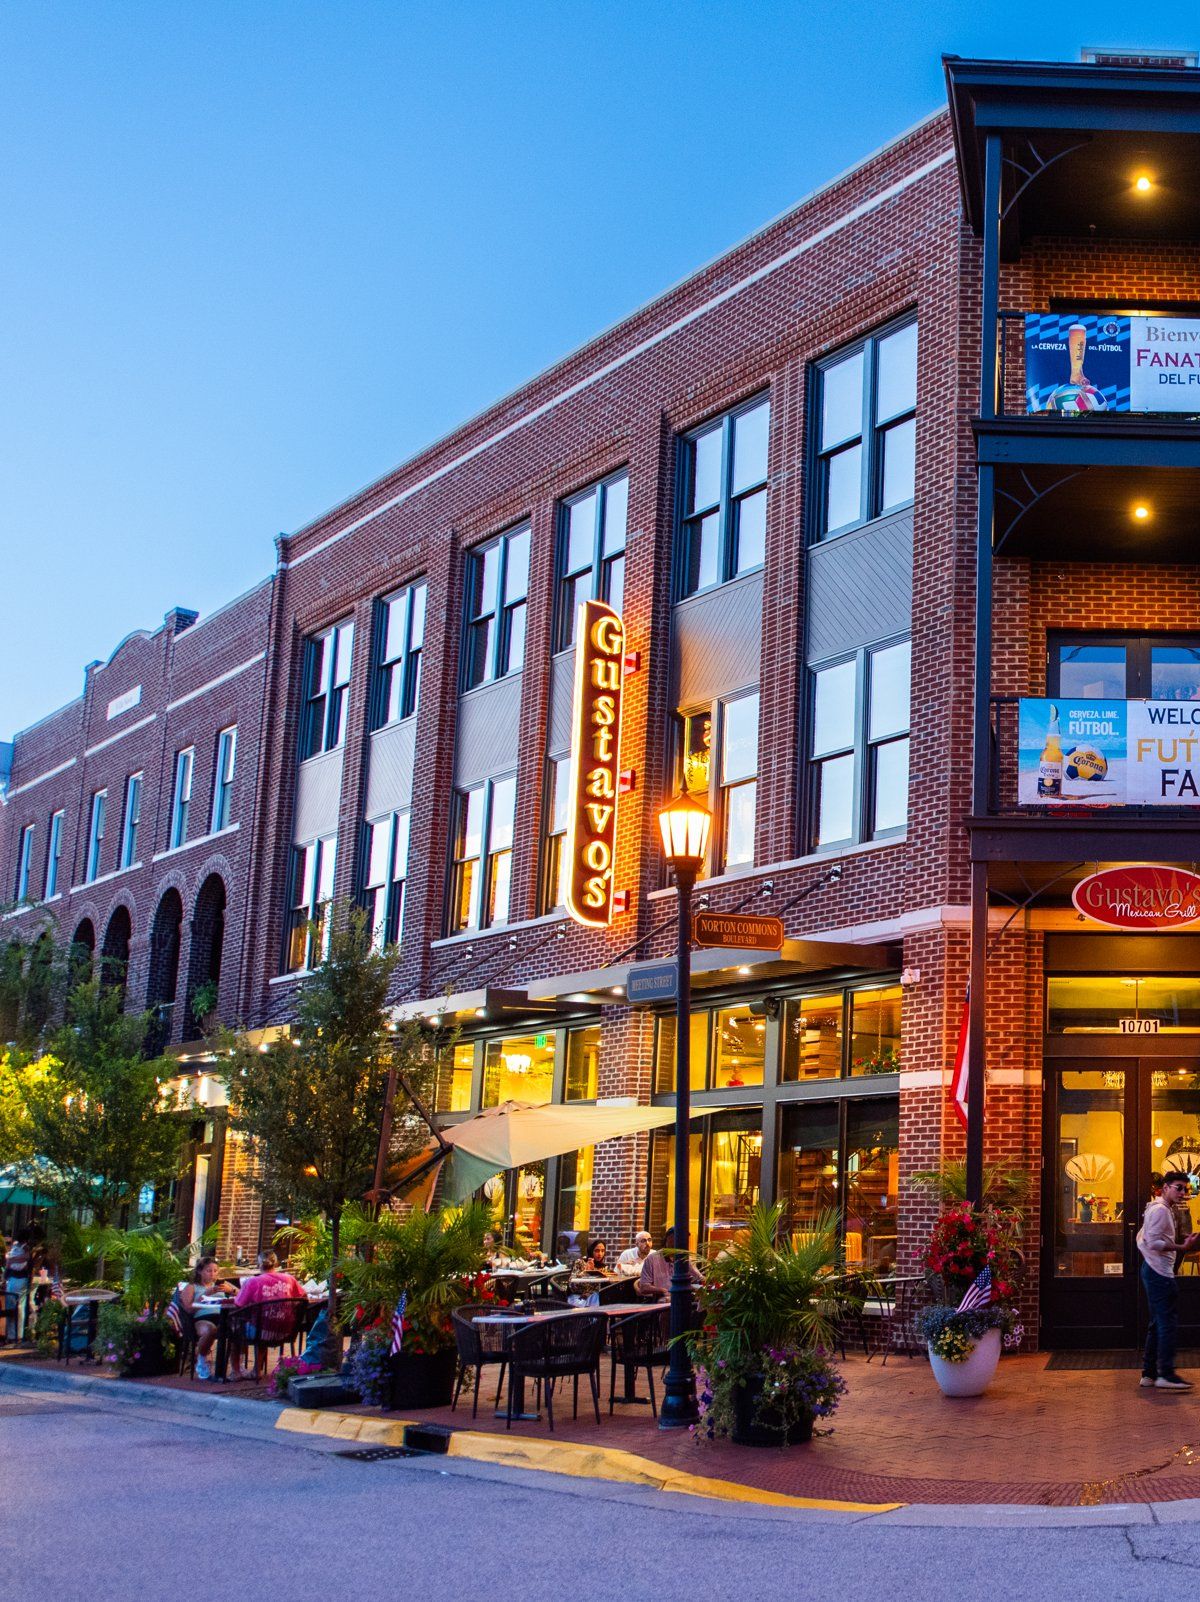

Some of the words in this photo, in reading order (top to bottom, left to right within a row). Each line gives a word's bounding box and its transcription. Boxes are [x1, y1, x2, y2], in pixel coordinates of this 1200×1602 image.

[1038, 343, 1067, 351] CERVEZA
[1098, 342, 1123, 352] FÚTBOL
[1159, 373, 1186, 385] DEL
[1101, 710, 1120, 719] LIME.
[582, 615, 624, 910] Gustavo's
[1109, 902, 1164, 918] Mexican
[1164, 903, 1198, 918] Grill
[701, 919, 736, 933] NORTON
[737, 922, 778, 936] COMMONS
[722, 934, 757, 945] BOULEVARD
[1121, 1020, 1158, 1033] 10701
